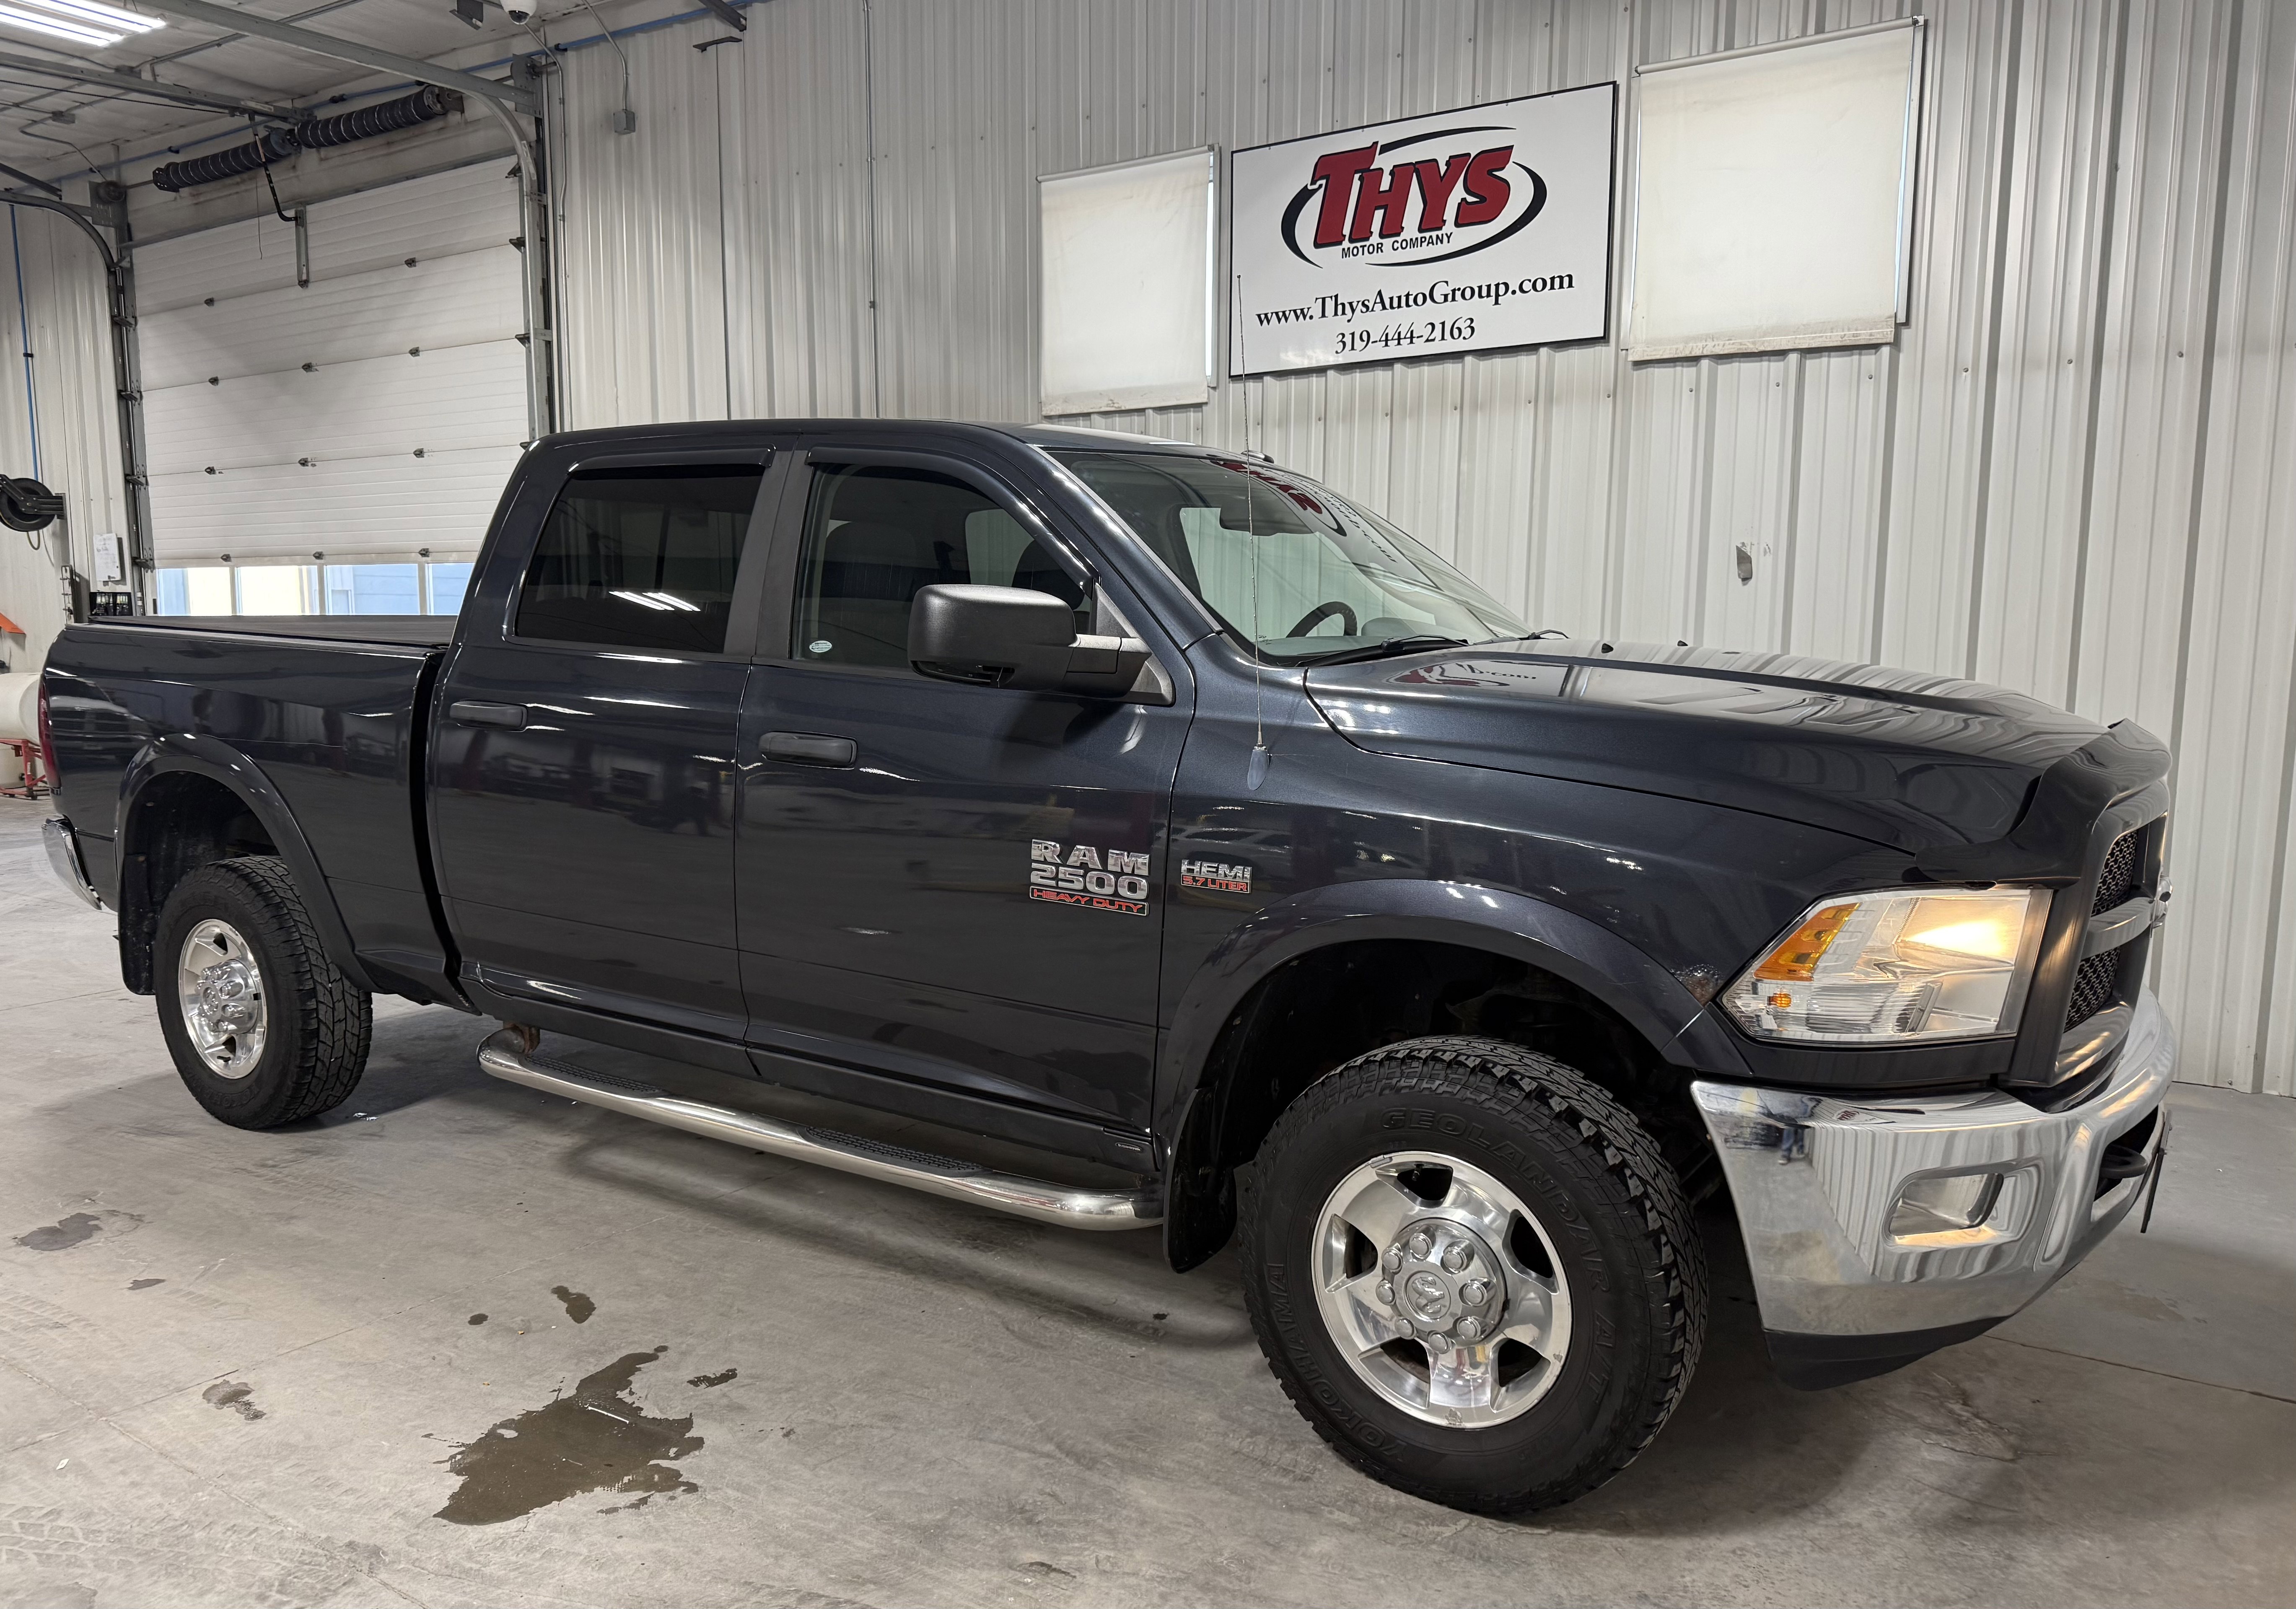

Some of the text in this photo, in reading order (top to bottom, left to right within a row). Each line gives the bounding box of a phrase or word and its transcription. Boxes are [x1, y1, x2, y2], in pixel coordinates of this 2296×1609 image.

[1307, 141, 1514, 248] THYS
[1342, 231, 1453, 259] MOTOR COMPANY
[1255, 272, 1575, 327] www.ThysAutoGroup.com
[1335, 316, 1476, 355] 319-444-2163
[1031, 839, 1151, 876] RAM
[1181, 859, 1253, 881] HEMI
[1030, 863, 1148, 900] 2500
[1183, 876, 1247, 892] 5.7 LITER
[1034, 888, 1143, 913] HEAVY DUTY
[1381, 1107, 1610, 1293] GEOLANDAR
[1266, 1263, 1407, 1462] YOKOHAMA
